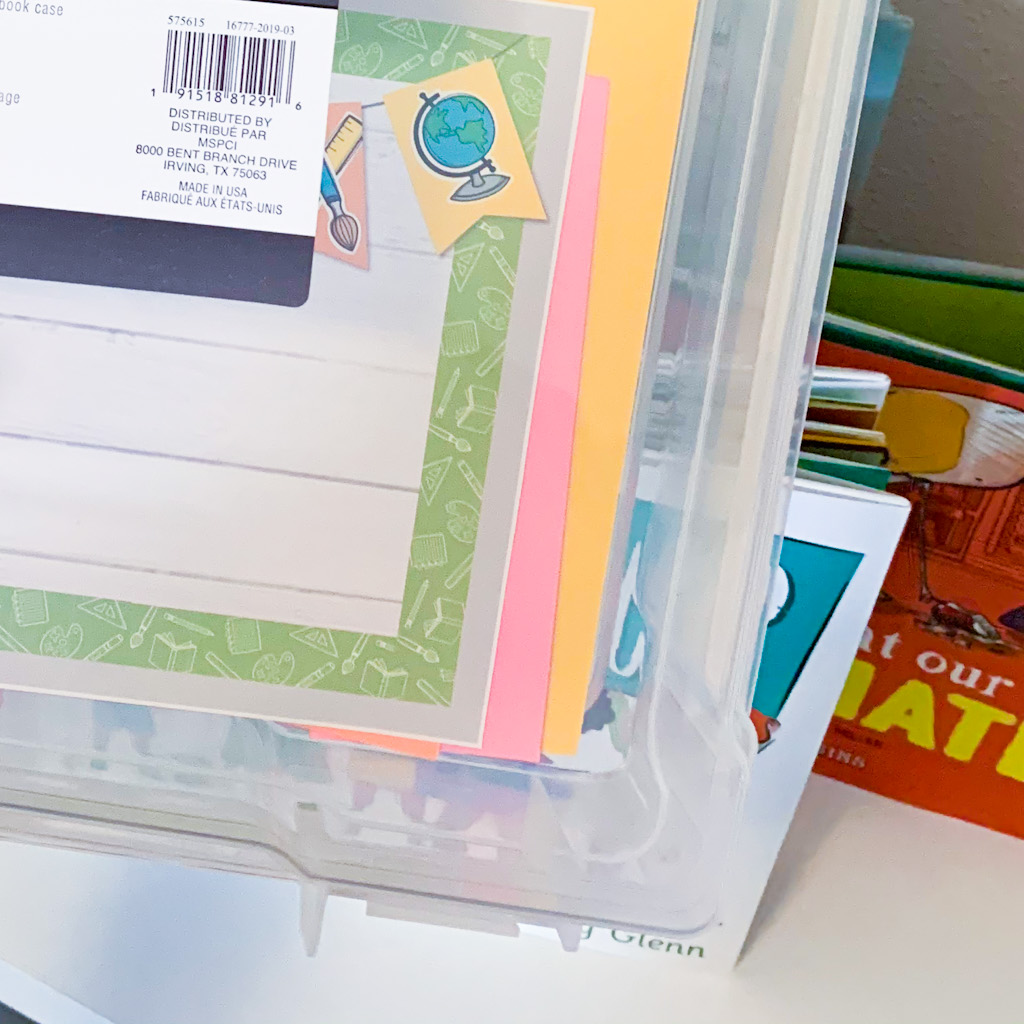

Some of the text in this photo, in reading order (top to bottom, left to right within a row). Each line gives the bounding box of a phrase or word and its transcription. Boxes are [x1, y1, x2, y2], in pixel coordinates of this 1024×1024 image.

[34, 3, 64, 16] case
[167, 15, 295, 35] 575615 16777-2019-03
[151, 88, 302, 111] 1 91518 81291 6
[169, 107, 272, 127] DISTRIBUTED BY
[171, 121, 267, 140] DISTRIBUÉ PAR
[197, 137, 237, 150] MSPCI
[135, 144, 298, 170] 8000 BENT BRANCH DRIVE
[163, 160, 267, 180] IRVING, TX 75063
[178, 181, 248, 198] MADE IN USA
[141, 190, 283, 215] FABRIQUÉ AUX ÉTATS-UNIS
[916, 650, 1015, 698] our
